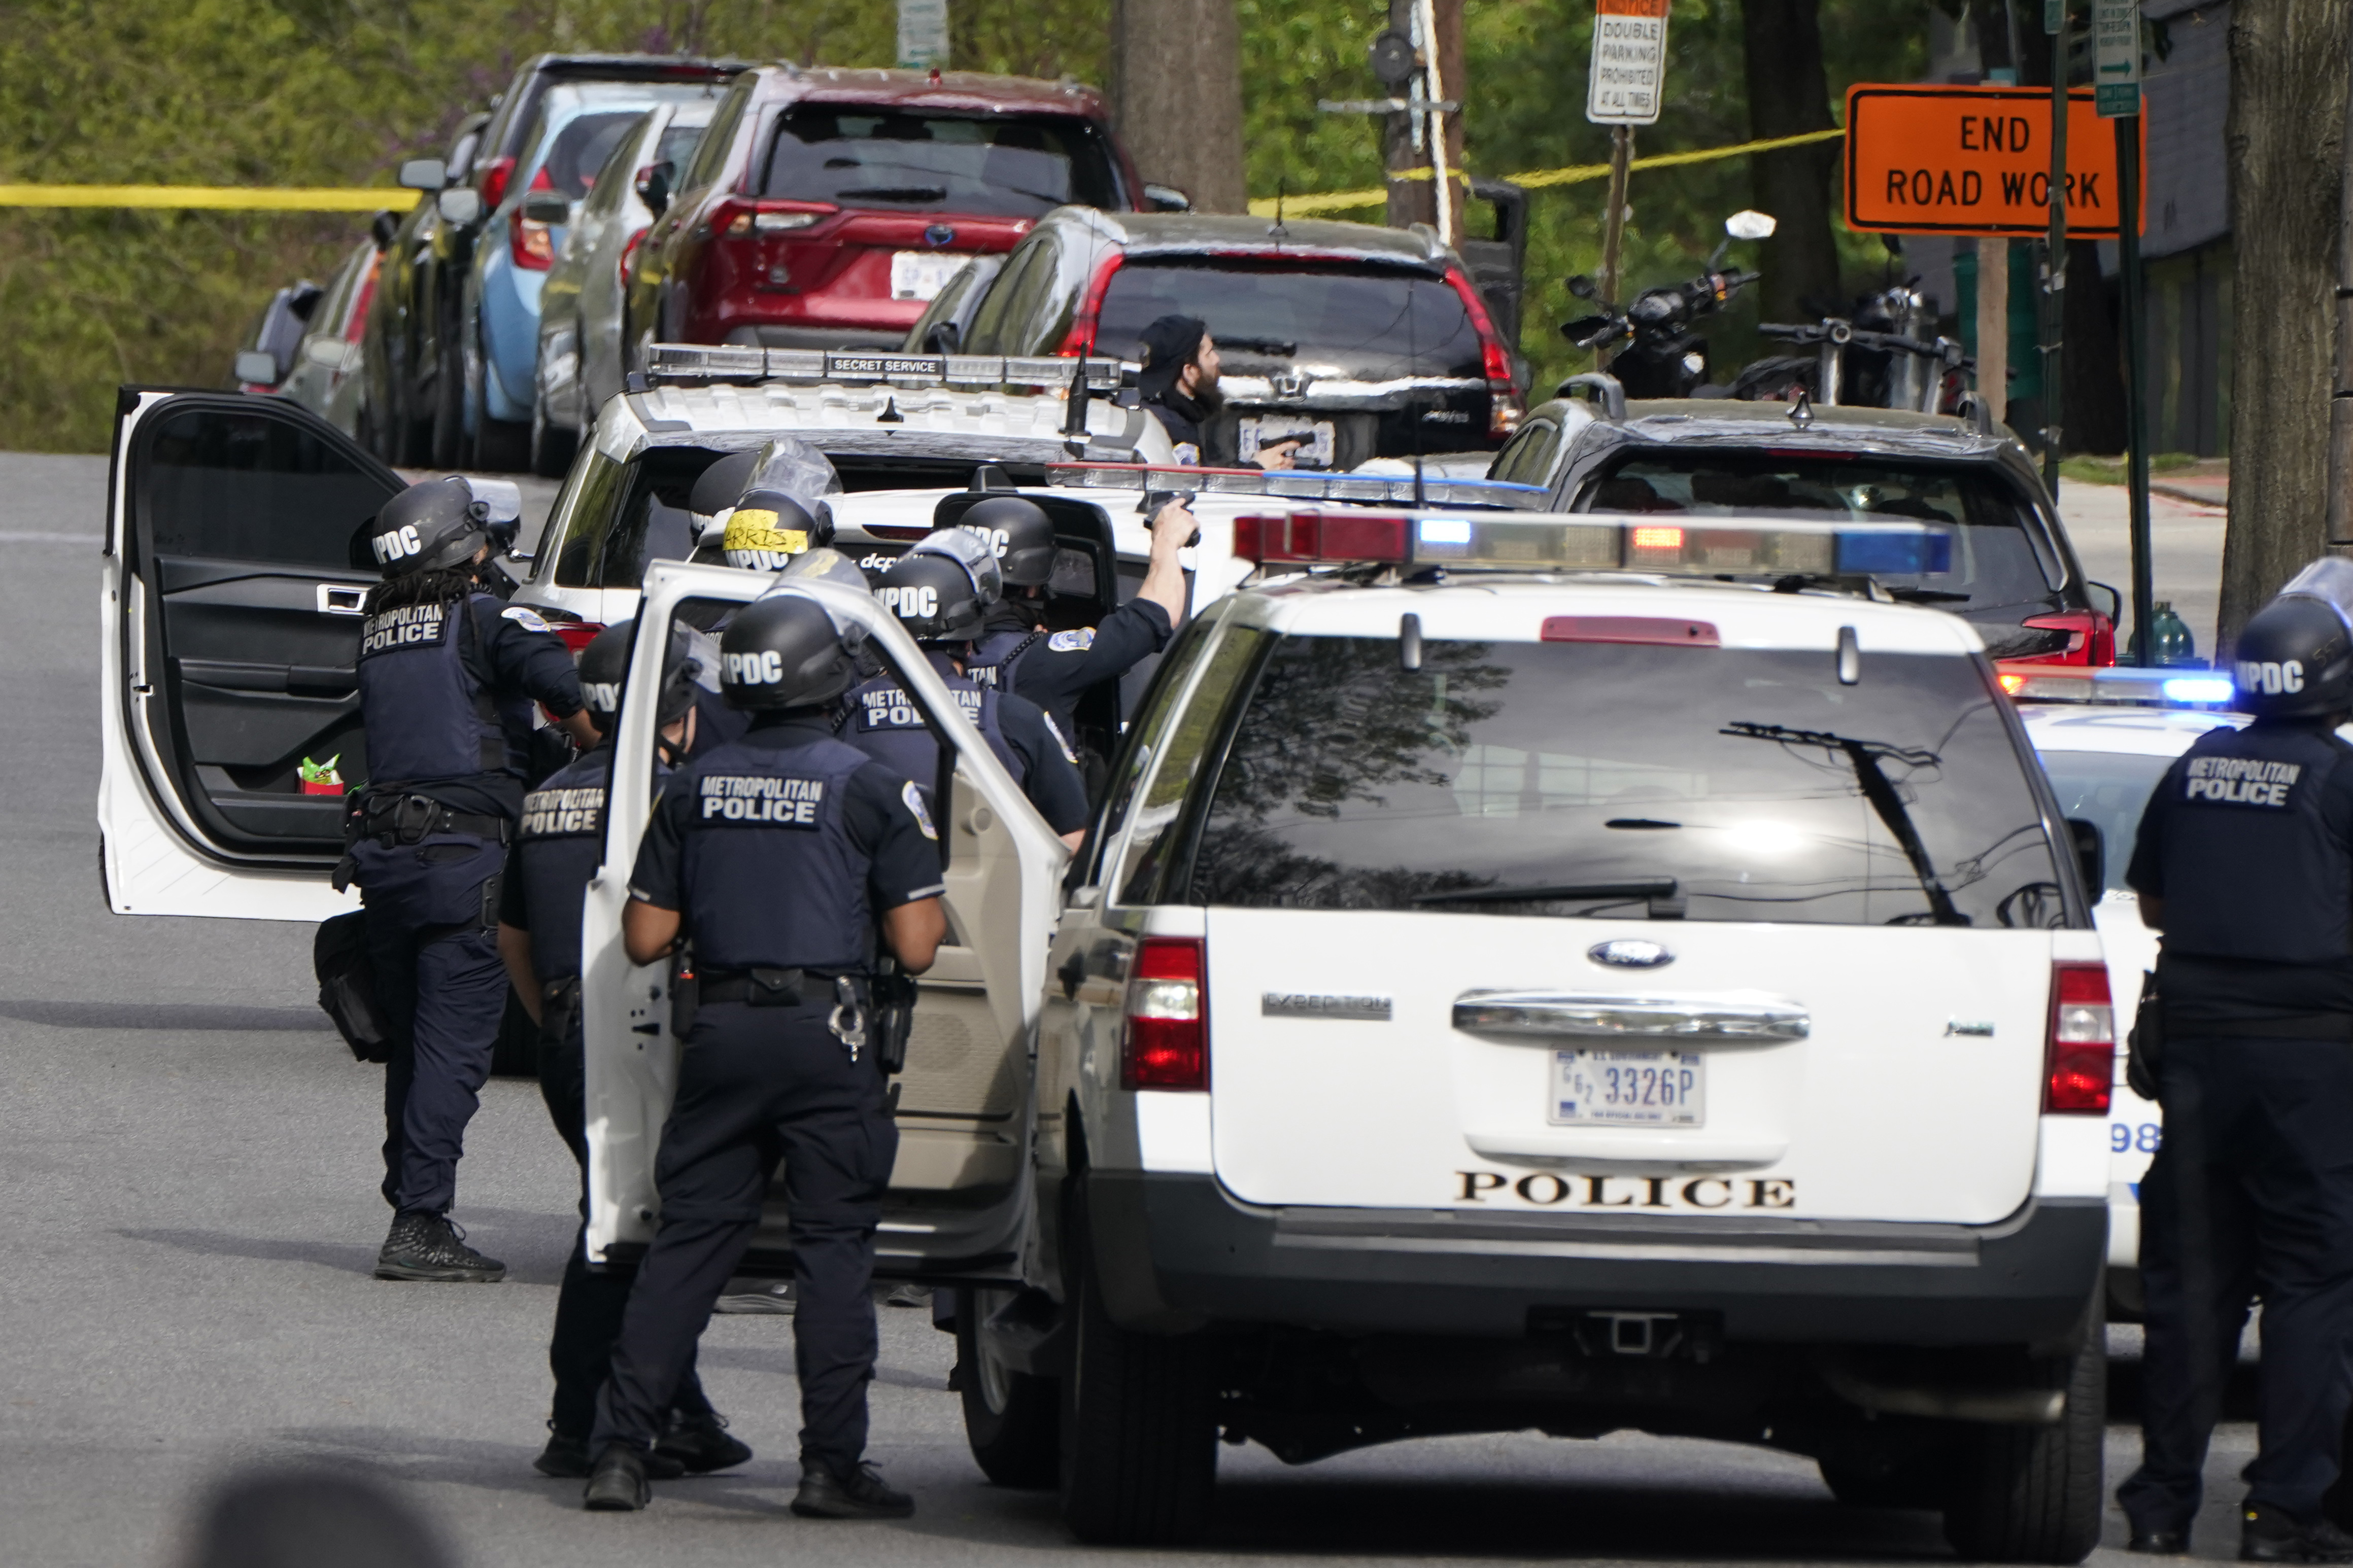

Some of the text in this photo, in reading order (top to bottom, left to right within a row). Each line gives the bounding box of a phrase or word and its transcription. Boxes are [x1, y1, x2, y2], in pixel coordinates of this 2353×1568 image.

[1604, 22, 1658, 40] DOUBLE
[1602, 44, 1658, 63] PARKING
[1600, 67, 1653, 86] PROHIBITED
[1961, 116, 2030, 153] END
[1887, 169, 2100, 208] ROAD WORK
[835, 359, 936, 372] SECRET SERVICE
[364, 604, 443, 639] METROPOLITAN
[362, 622, 439, 654] POLICE
[868, 706, 980, 726] POLE
[2187, 756, 2301, 784] METROPOLITAN
[700, 776, 823, 802] METROPOLITAN
[2187, 778, 2289, 806] POLICE
[520, 810, 598, 834] POLICE
[702, 797, 816, 823] POLICE
[1605, 1067, 1693, 1106] 3326P
[2111, 1123, 2161, 1154] 98
[1454, 1171, 1795, 1209] POLICE
